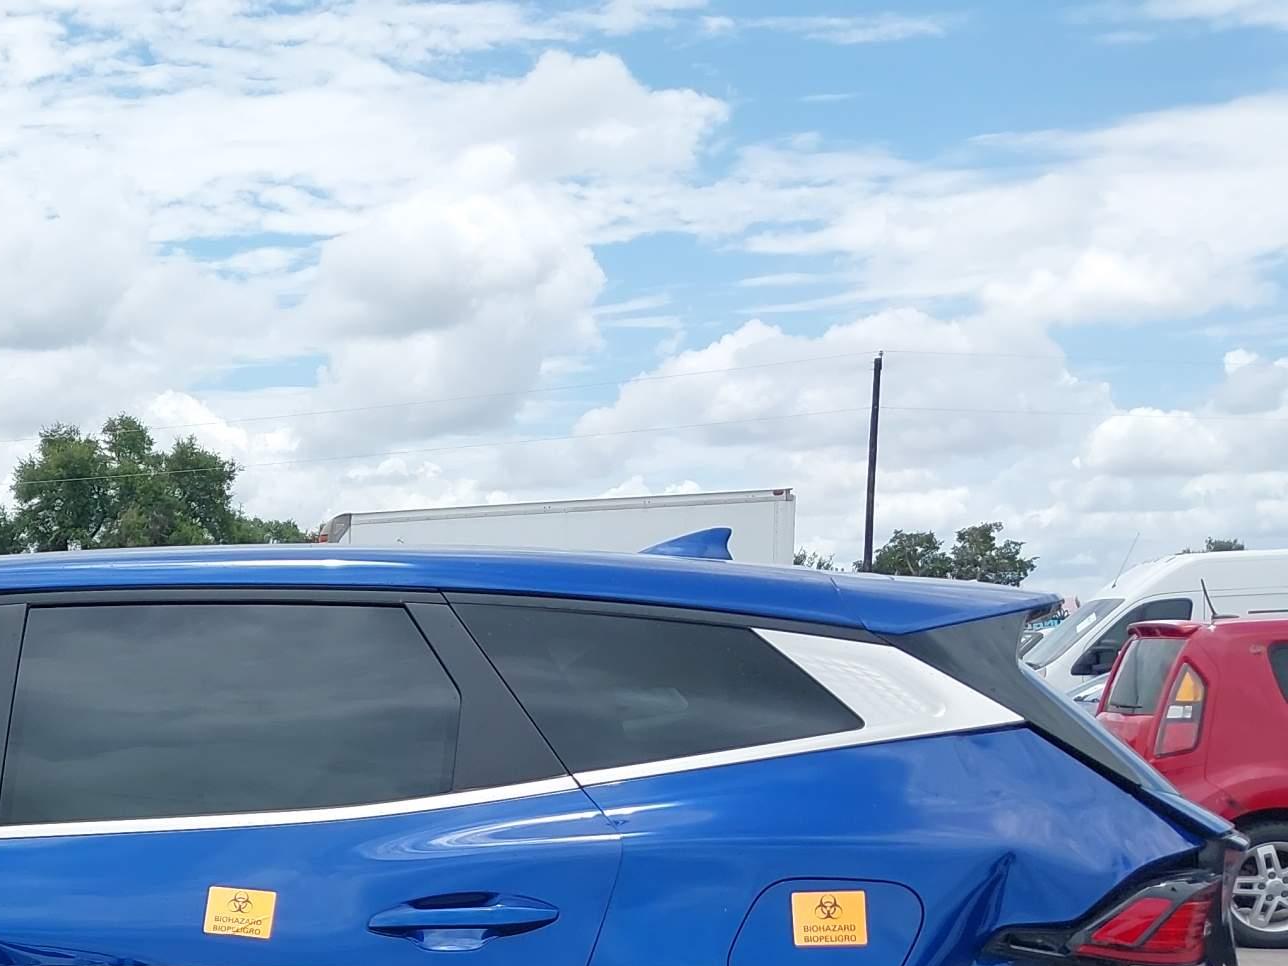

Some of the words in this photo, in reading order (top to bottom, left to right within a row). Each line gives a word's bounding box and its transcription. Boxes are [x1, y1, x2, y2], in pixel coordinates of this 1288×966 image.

[214, 916, 262, 925] BIOHAZARD
[803, 924, 856, 933] BIOHAZARD
[804, 934, 857, 943] BIOPELIGRO
